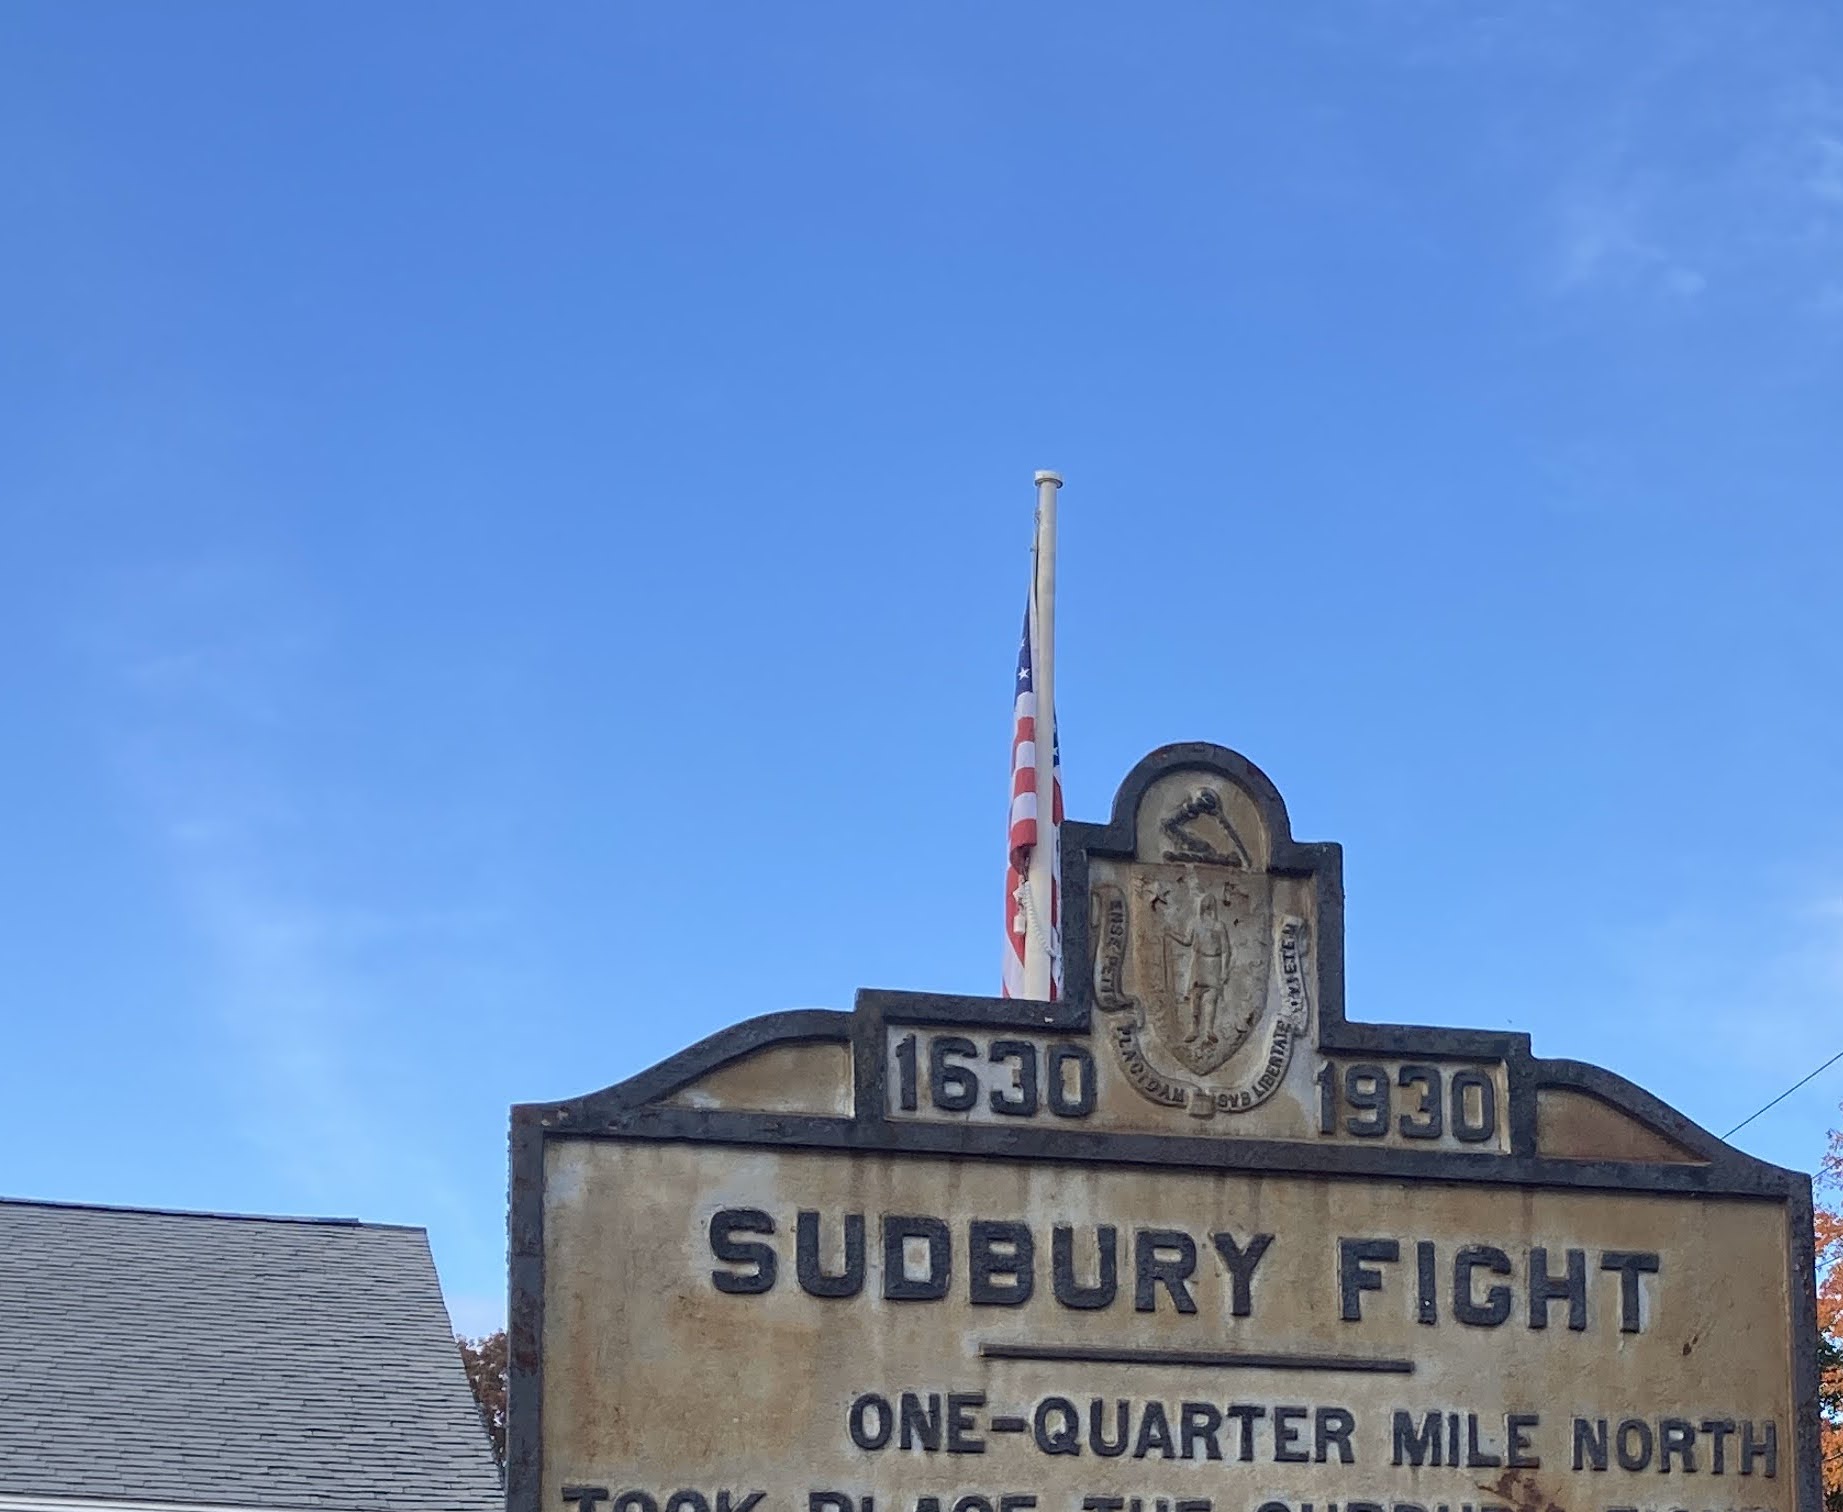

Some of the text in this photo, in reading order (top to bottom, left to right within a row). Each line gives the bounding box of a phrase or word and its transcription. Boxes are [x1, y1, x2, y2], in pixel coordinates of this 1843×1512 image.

[896, 1033, 1496, 1143] 1630 1930
[708, 1208, 1660, 1333] SUDBURY FIGHT
[848, 1392, 1777, 1478] ONE-QUARTER MILE NORTH
